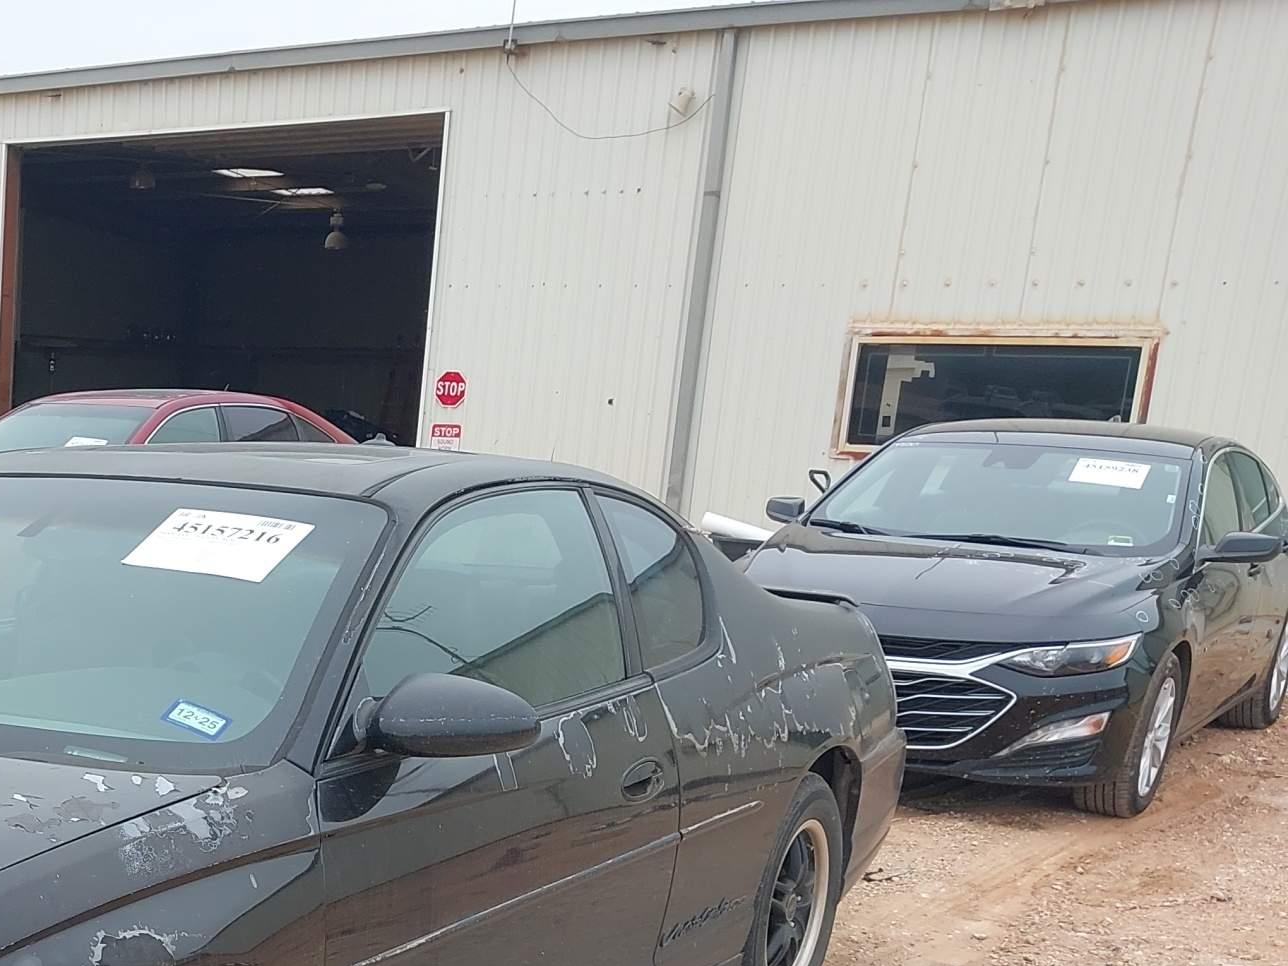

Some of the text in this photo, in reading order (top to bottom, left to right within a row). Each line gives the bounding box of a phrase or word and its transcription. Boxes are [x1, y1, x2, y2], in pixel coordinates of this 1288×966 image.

[436, 381, 465, 396] STOP
[433, 426, 460, 437] STOP
[172, 520, 281, 545] 45157216
